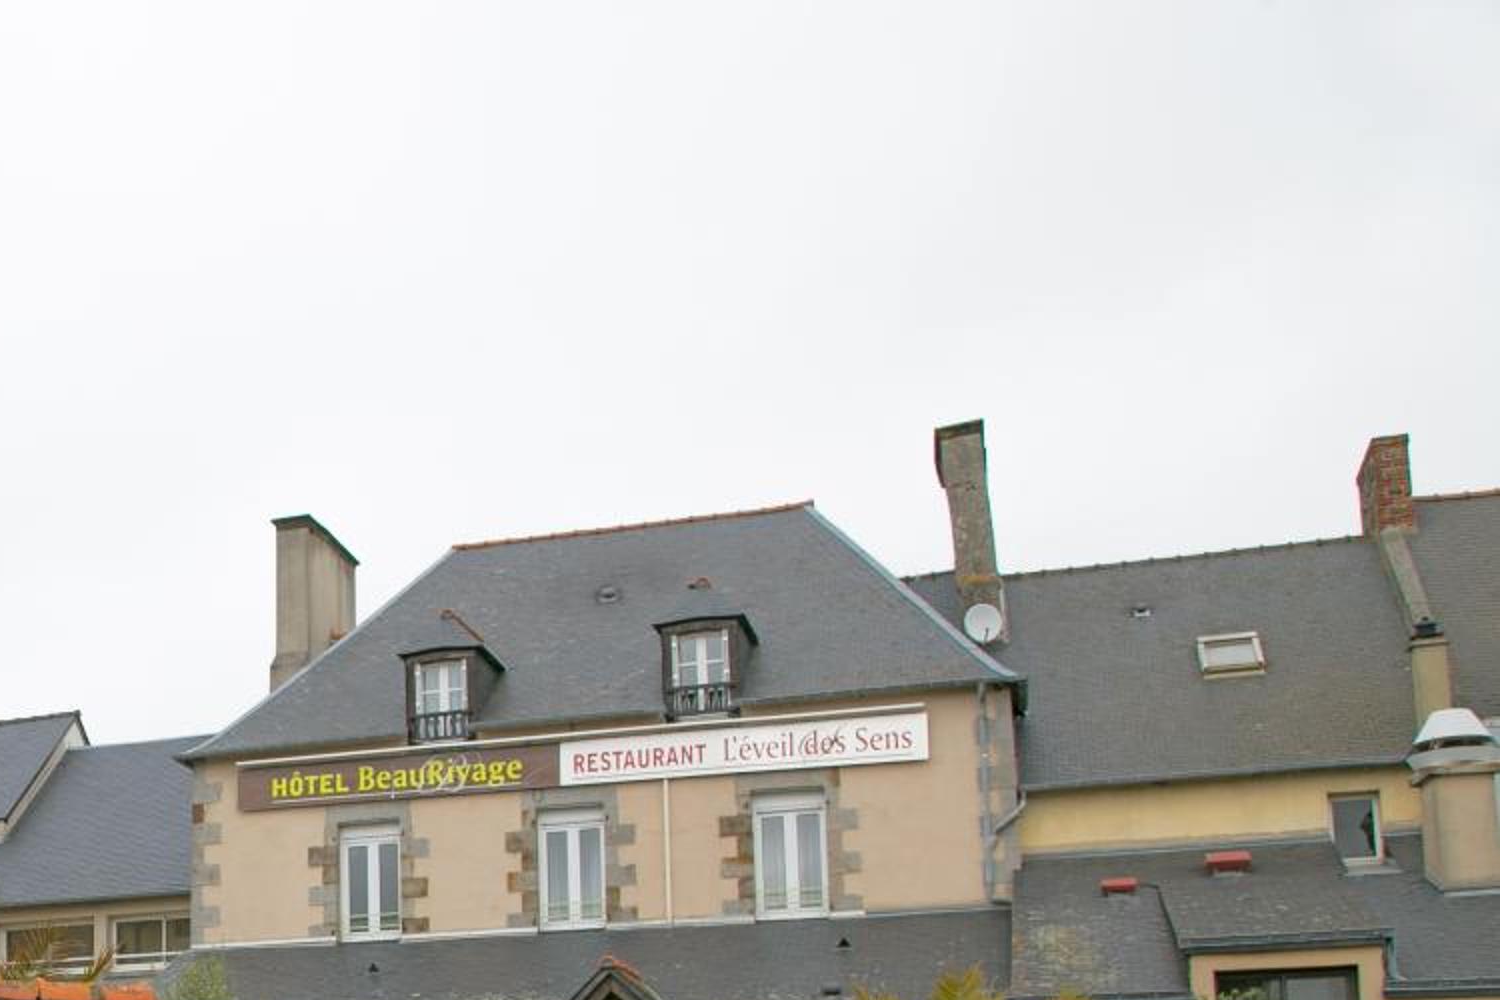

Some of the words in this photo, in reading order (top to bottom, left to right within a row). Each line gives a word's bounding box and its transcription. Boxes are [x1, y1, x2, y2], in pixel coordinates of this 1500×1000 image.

[573, 743, 707, 774] RESTAURANT
[723, 731, 794, 761] L'éveil
[803, 729, 846, 755] des
[855, 726, 913, 752] Sens
[271, 771, 348, 798] HÔTEL
[358, 758, 523, 791] BeauRivage
